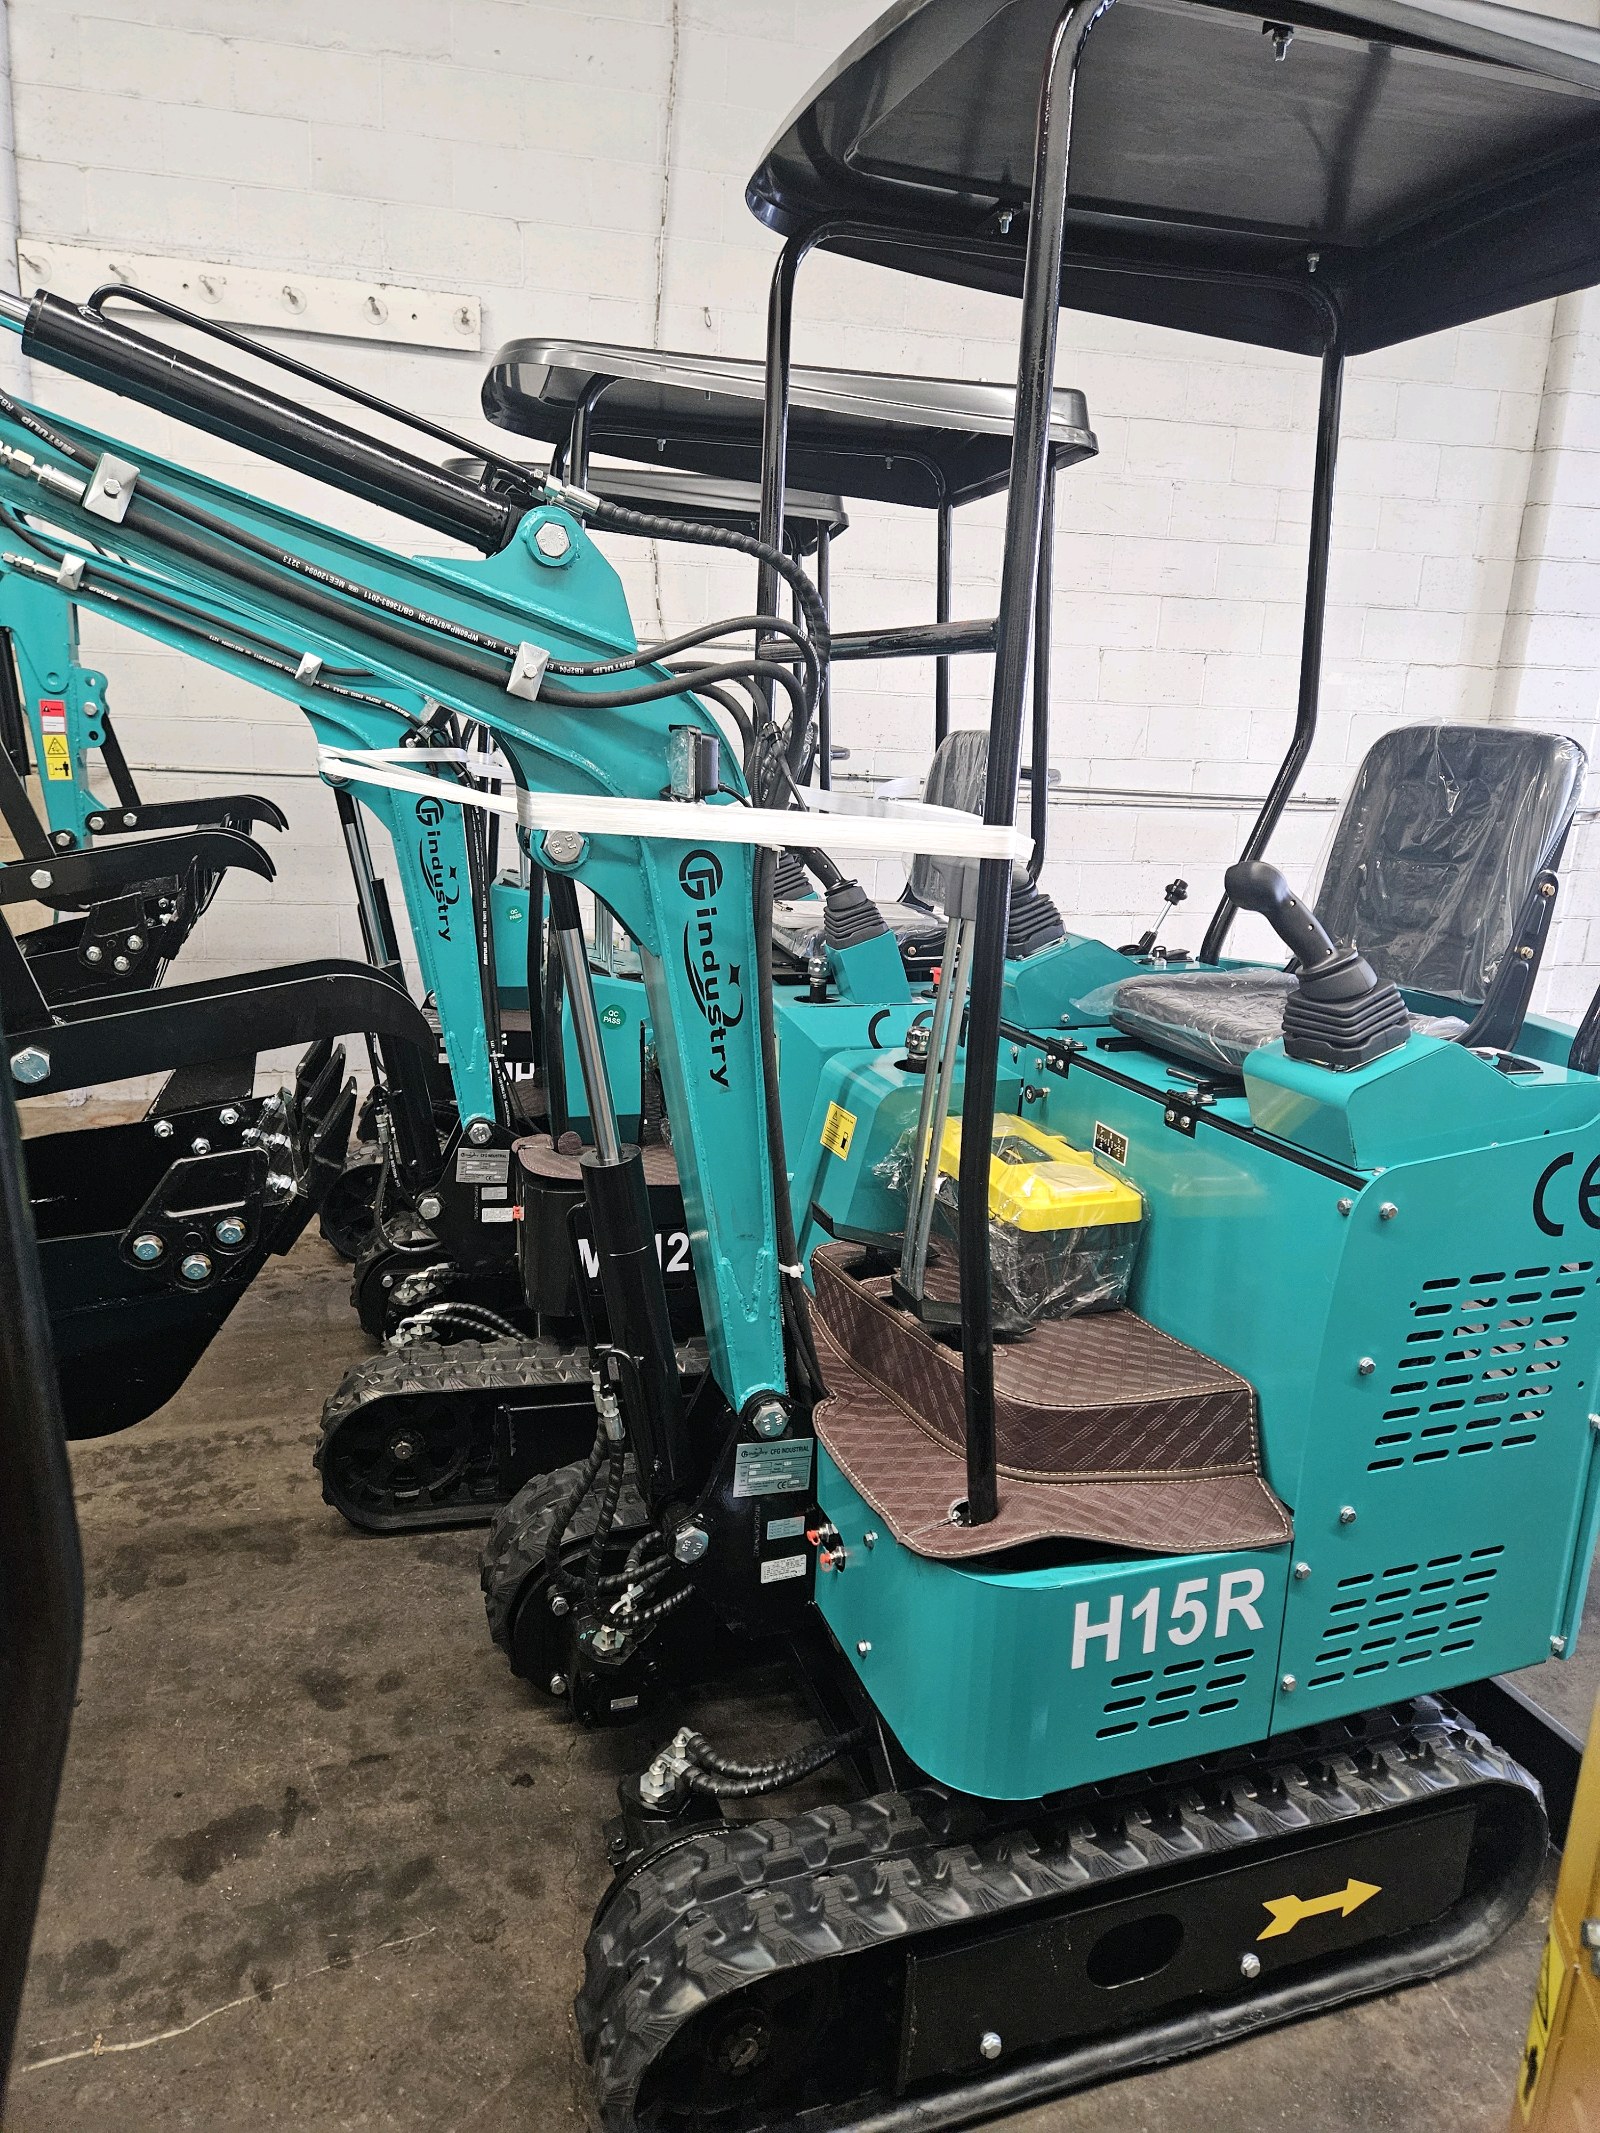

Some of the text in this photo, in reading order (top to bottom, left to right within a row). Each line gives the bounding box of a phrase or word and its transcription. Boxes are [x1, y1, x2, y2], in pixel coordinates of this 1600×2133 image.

[20, 414, 76, 457] MATULIP
[592, 660, 635, 673] MATULIP
[608, 1009, 619, 1018] QC
[603, 1015, 621, 1025] PASS
[781, 1445, 809, 1455] INDUSTRIAL
[1071, 1568, 1264, 1670] H15R
